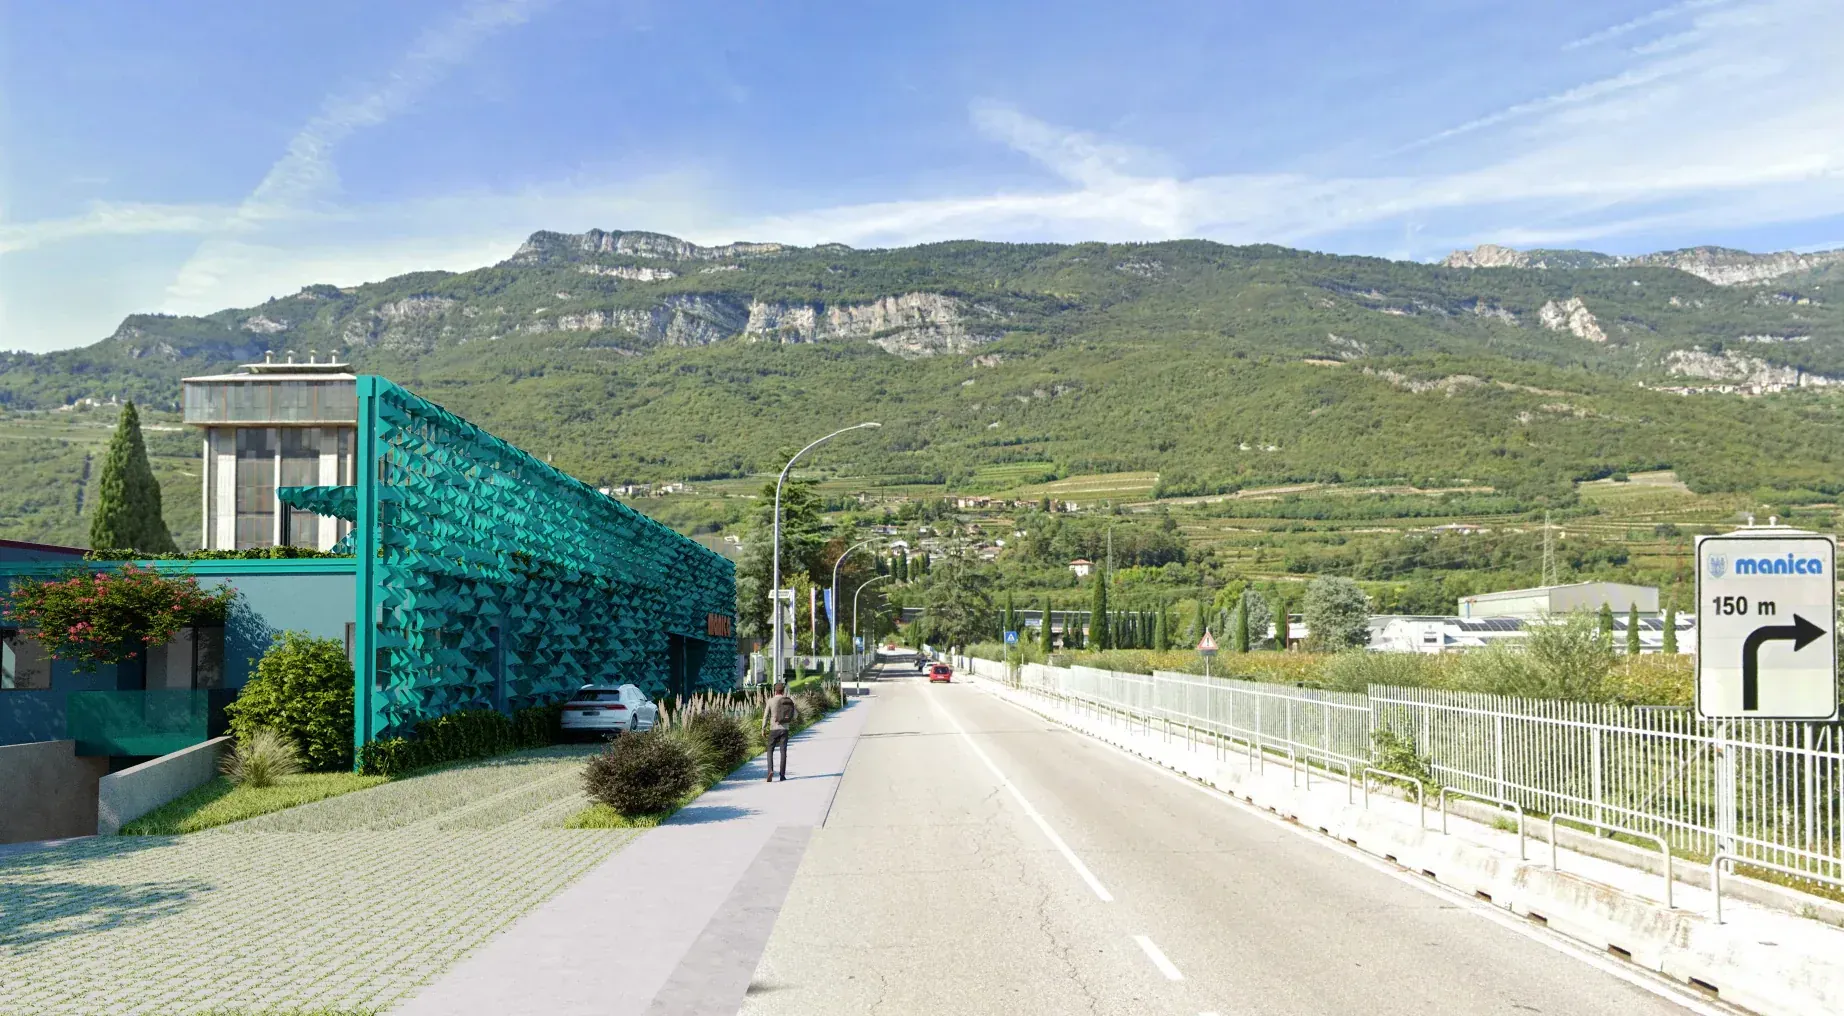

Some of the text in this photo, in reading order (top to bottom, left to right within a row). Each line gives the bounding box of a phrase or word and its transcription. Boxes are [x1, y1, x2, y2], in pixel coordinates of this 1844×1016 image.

[1735, 553, 1823, 574] manica
[1712, 596, 1776, 616] 150 m
